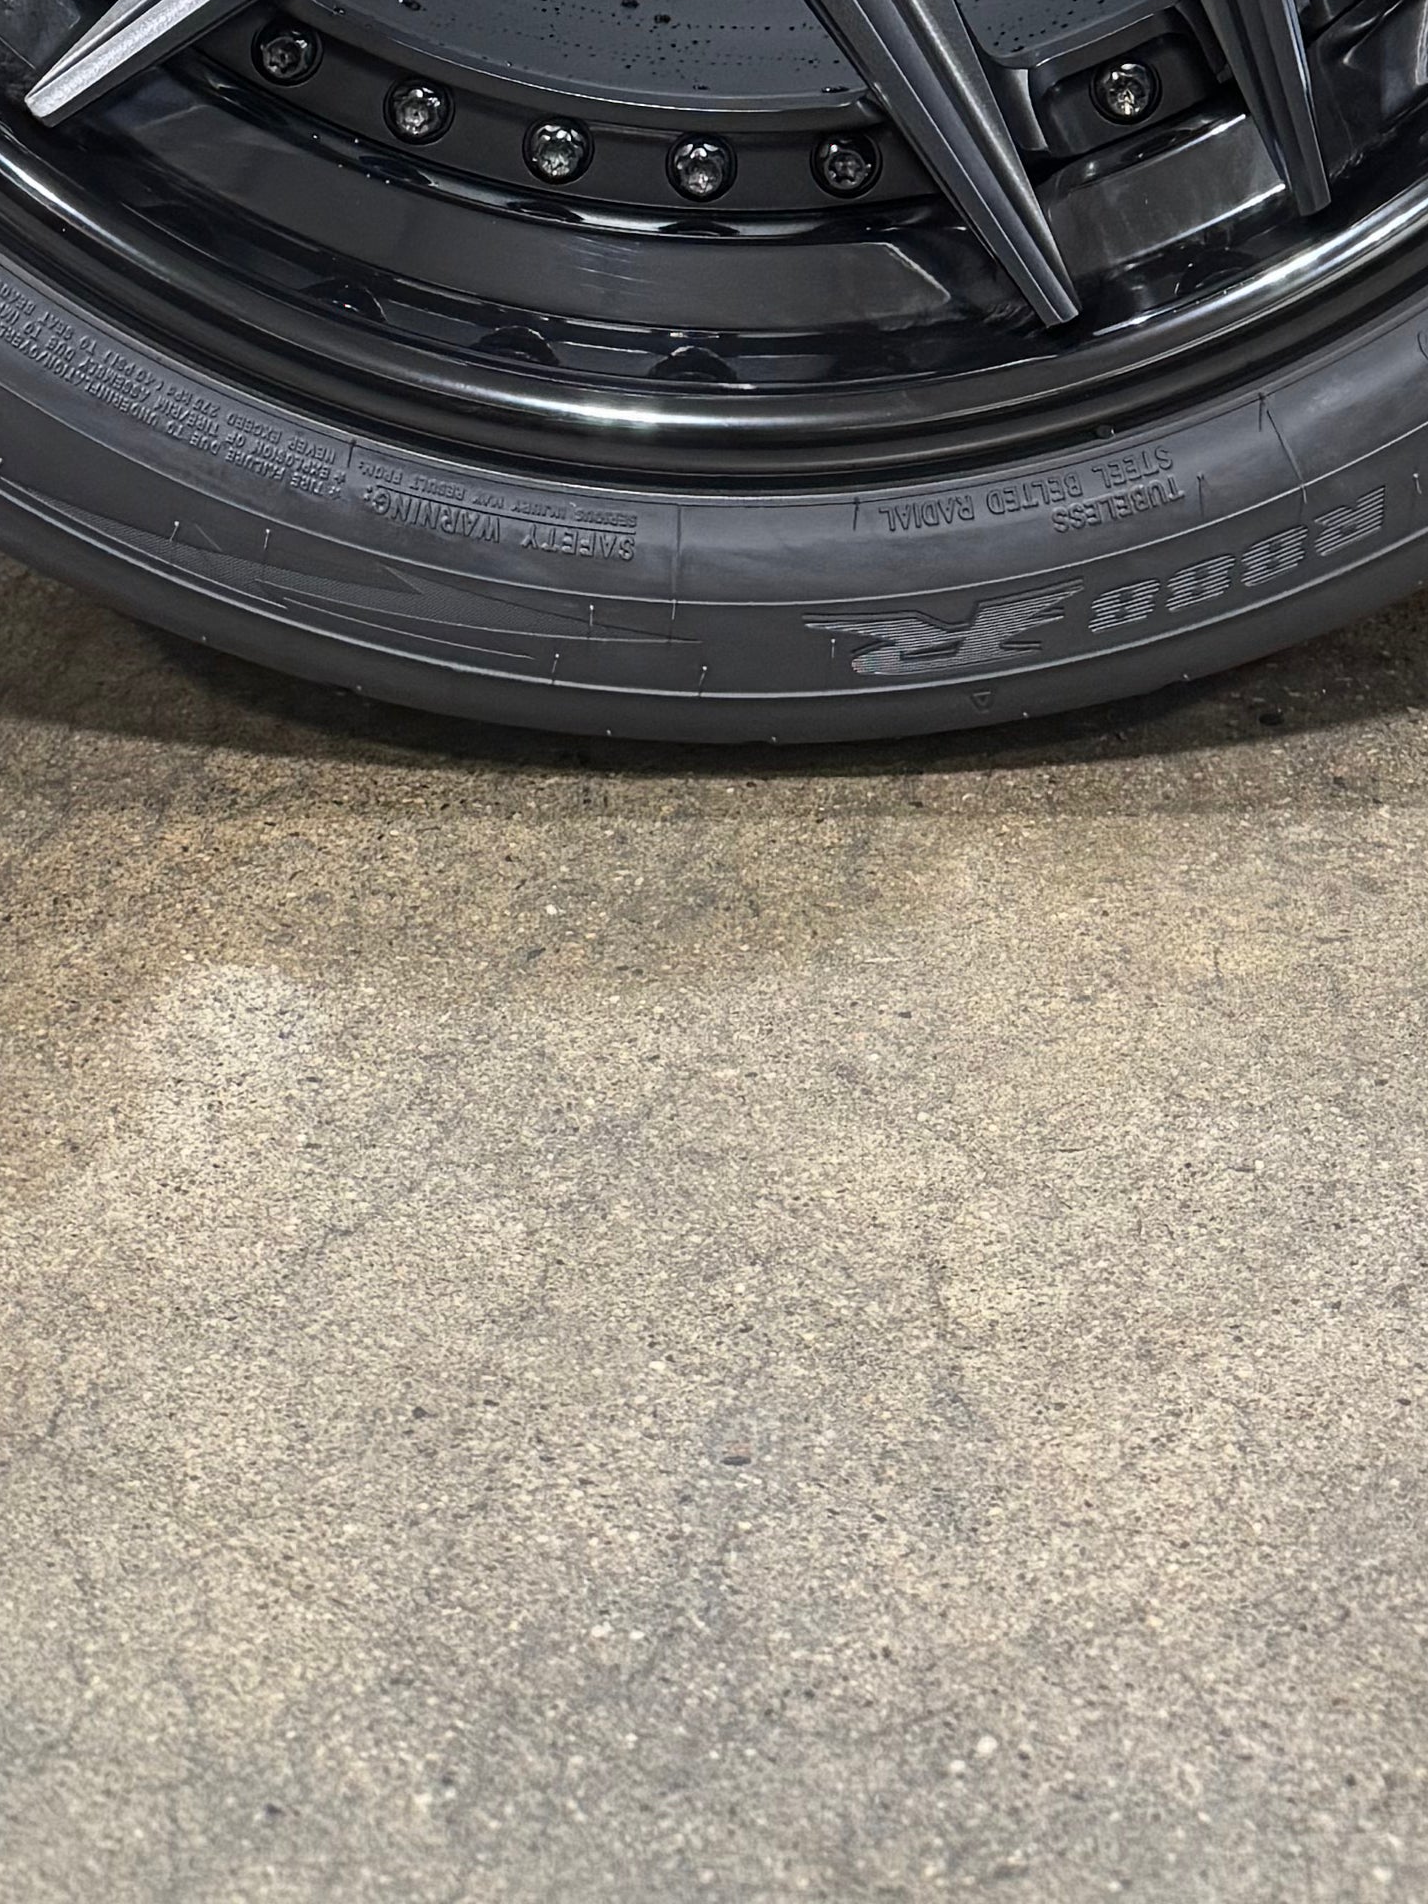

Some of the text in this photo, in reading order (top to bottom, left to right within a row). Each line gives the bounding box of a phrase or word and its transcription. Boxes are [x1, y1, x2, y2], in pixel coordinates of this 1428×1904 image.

[359, 484, 635, 562] SAFETY WARNING:
[876, 441, 1175, 534] STEEL BELTED RADIAL
[1048, 475, 1186, 536] TUBELESS
